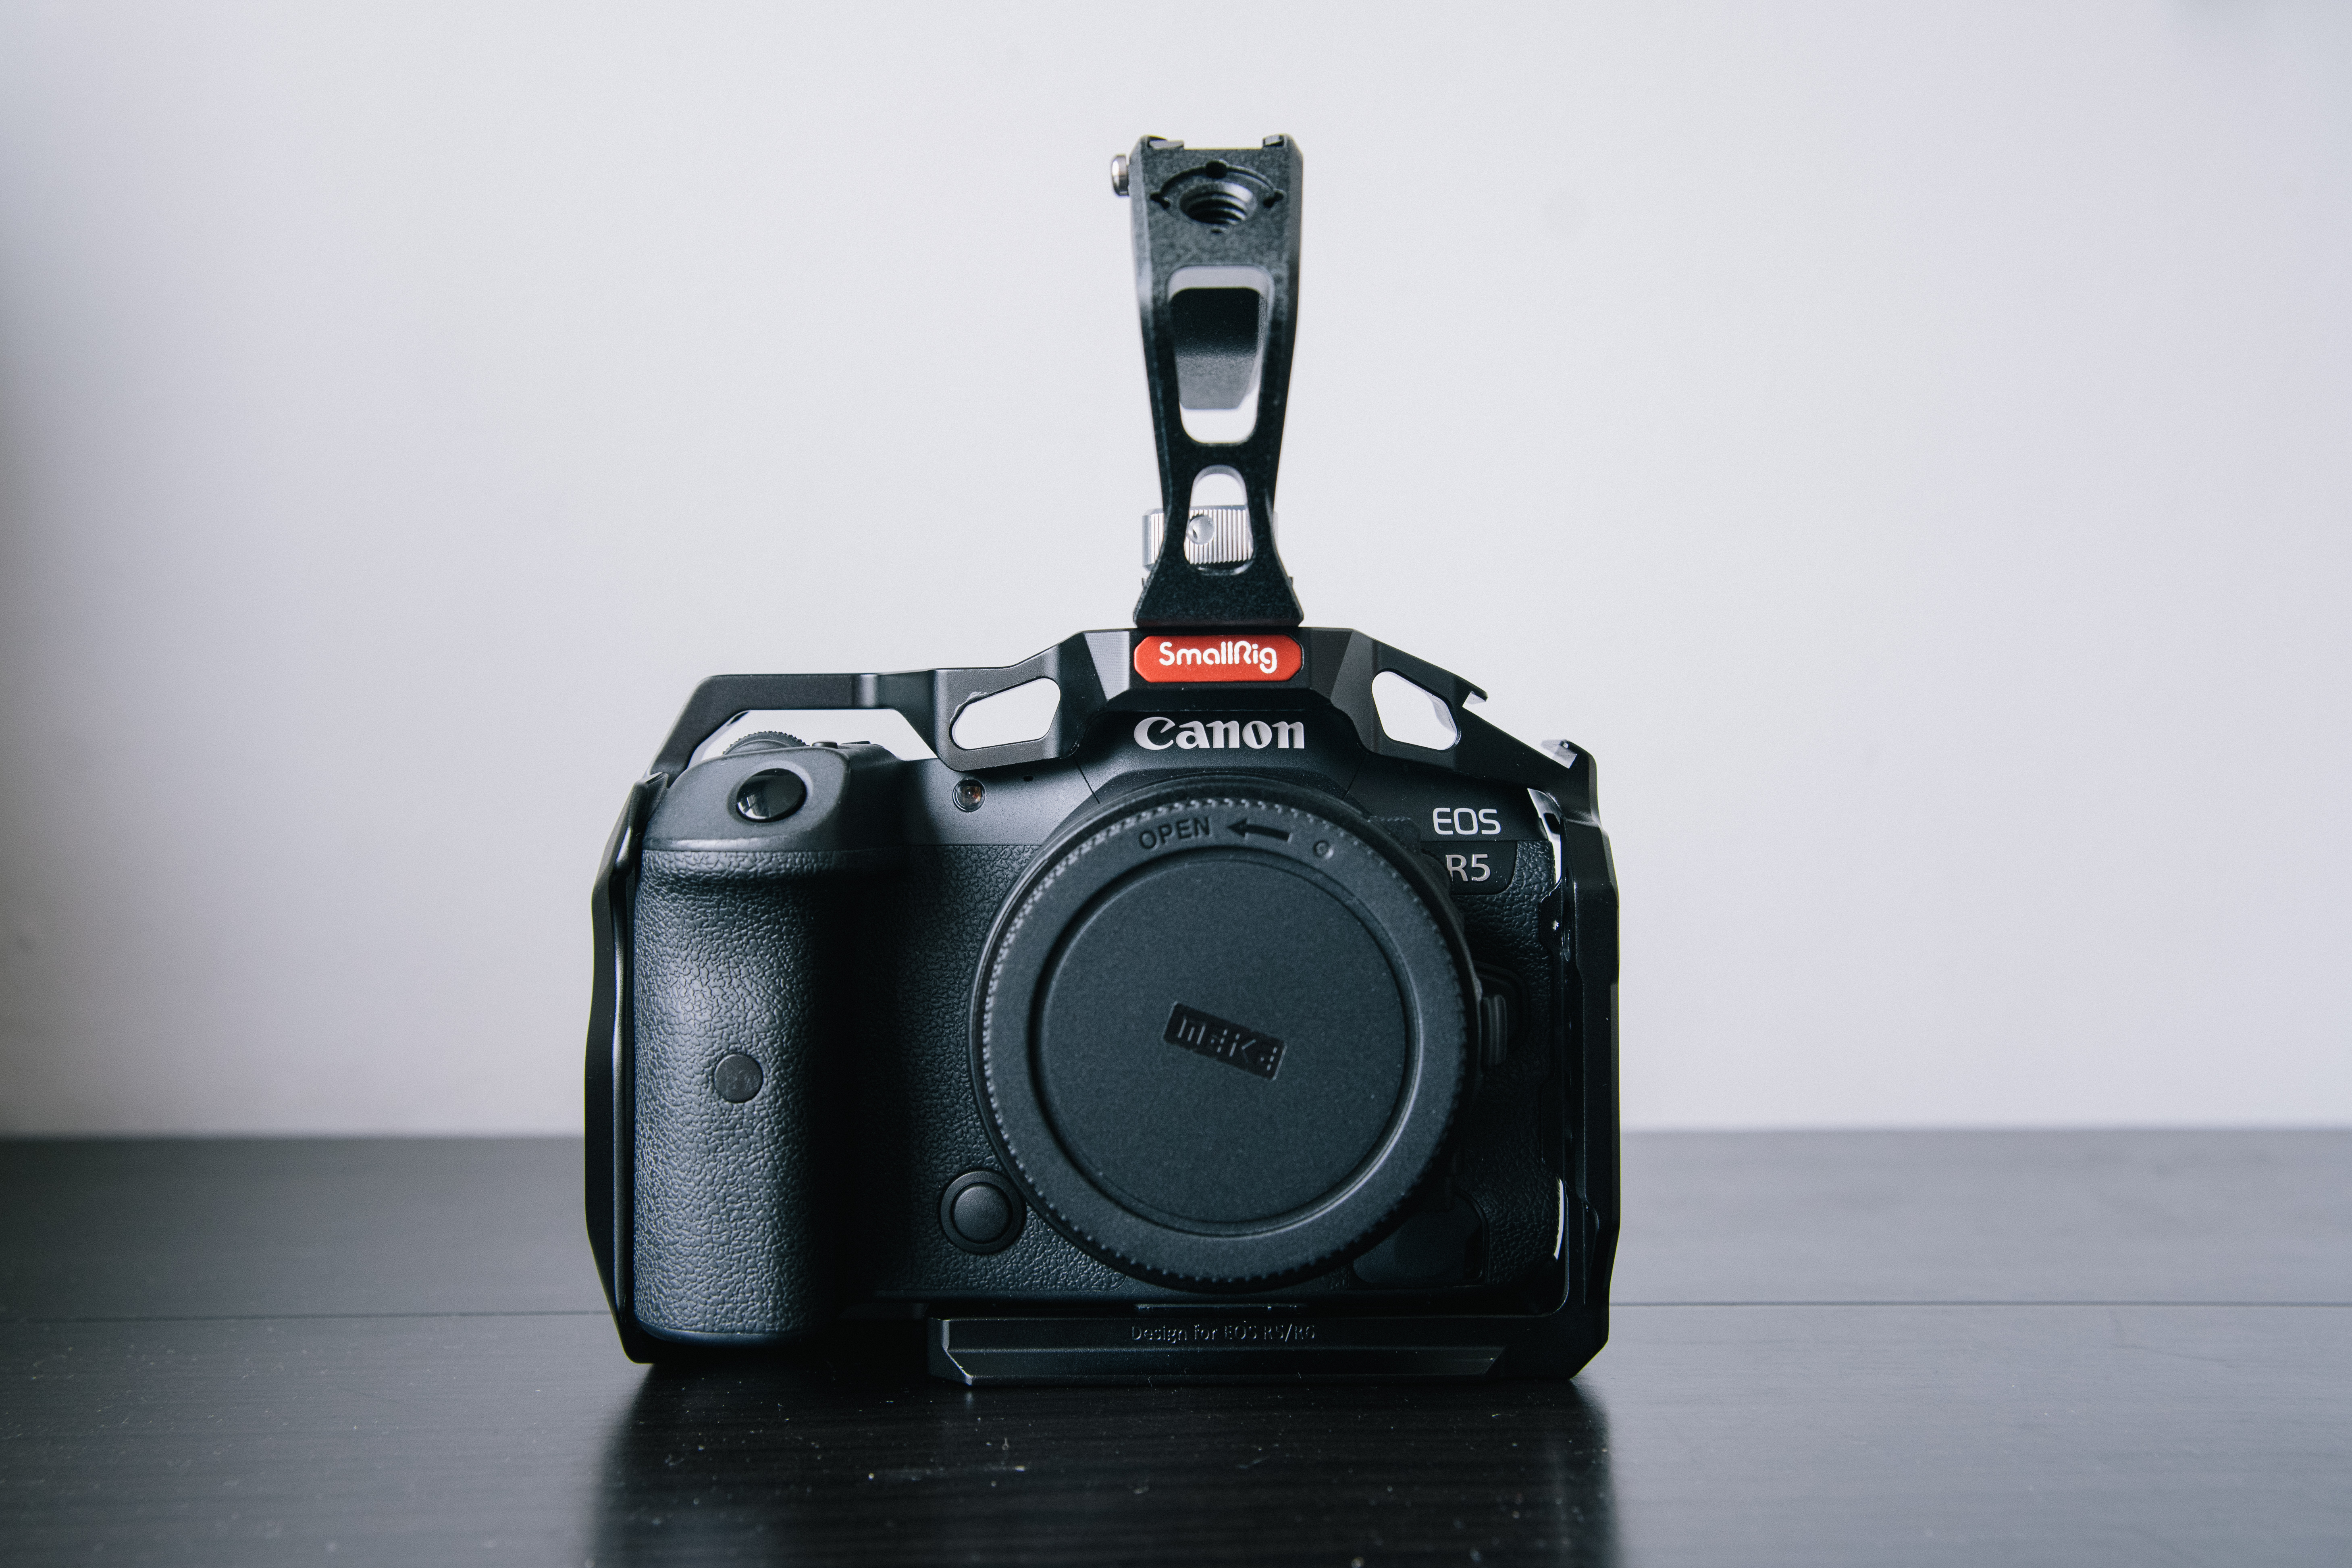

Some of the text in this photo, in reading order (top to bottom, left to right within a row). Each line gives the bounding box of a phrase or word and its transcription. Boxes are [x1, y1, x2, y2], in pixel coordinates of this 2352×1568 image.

[1158, 640, 1277, 674] SmallRig
[1133, 716, 1305, 751] Canon
[1138, 816, 1210, 850] OPEN
[1433, 807, 1501, 835] EOS
[1445, 854, 1491, 882] R5
[1131, 1323, 1315, 1344] Design for EOS R5/R6
